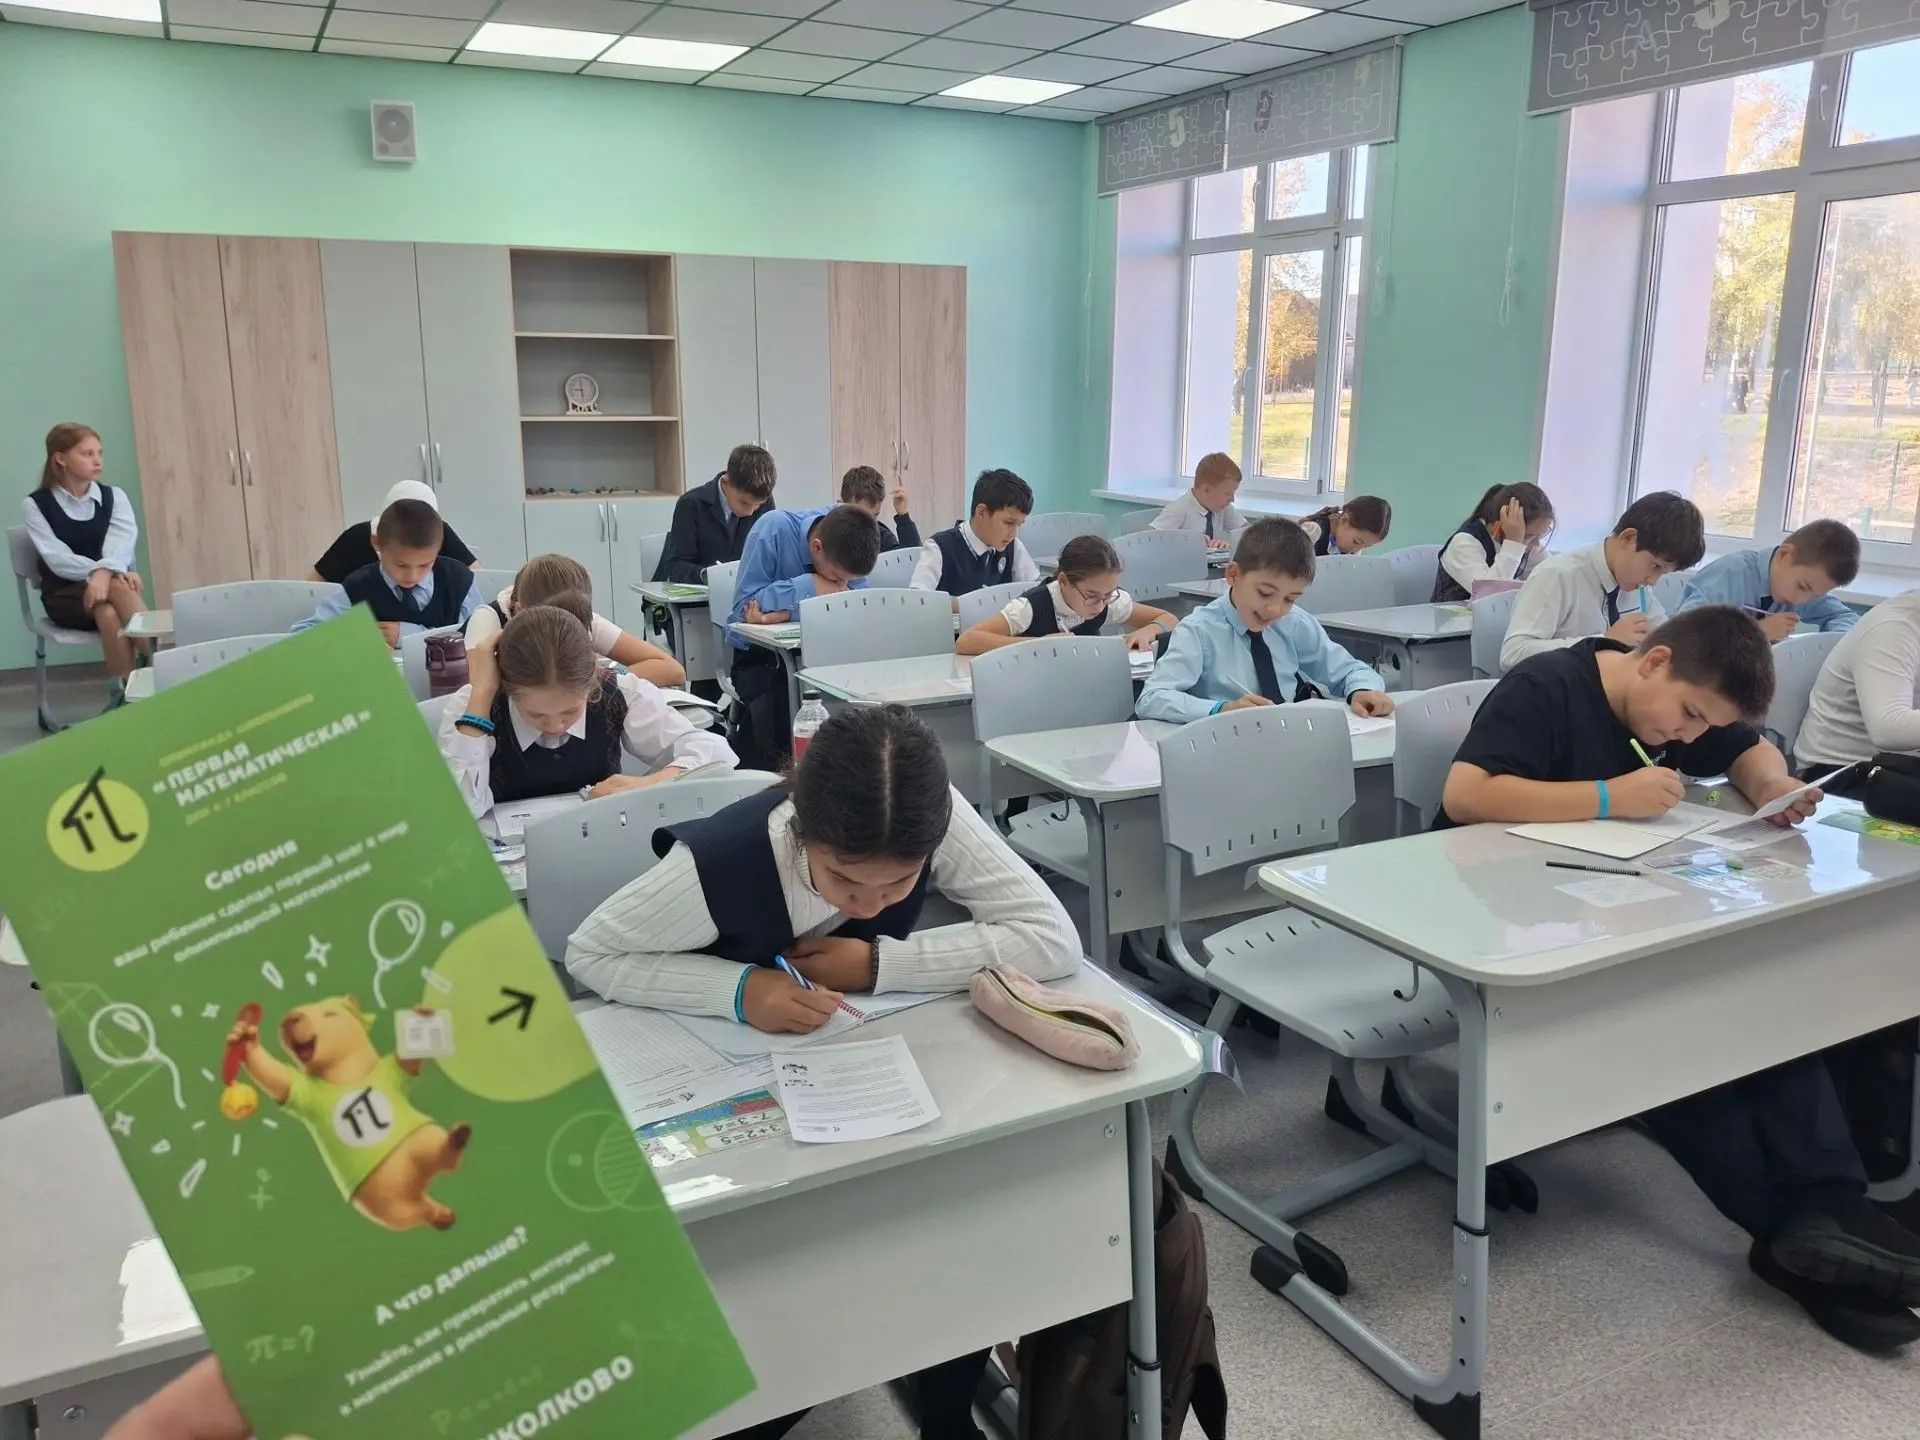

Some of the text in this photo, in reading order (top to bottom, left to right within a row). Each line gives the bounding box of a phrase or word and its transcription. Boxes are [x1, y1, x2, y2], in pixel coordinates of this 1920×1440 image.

[204, 839, 299, 891] Сегодня
[218, 885, 275, 917] сделал
[275, 853, 335, 891] первый
[377, 820, 409, 844] мир
[282, 861, 373, 911] математики
[375, 1224, 528, 1326] А что дальше?
[413, 1326, 442, 1349] как
[476, 1355, 635, 1440] КОЛКОВО
